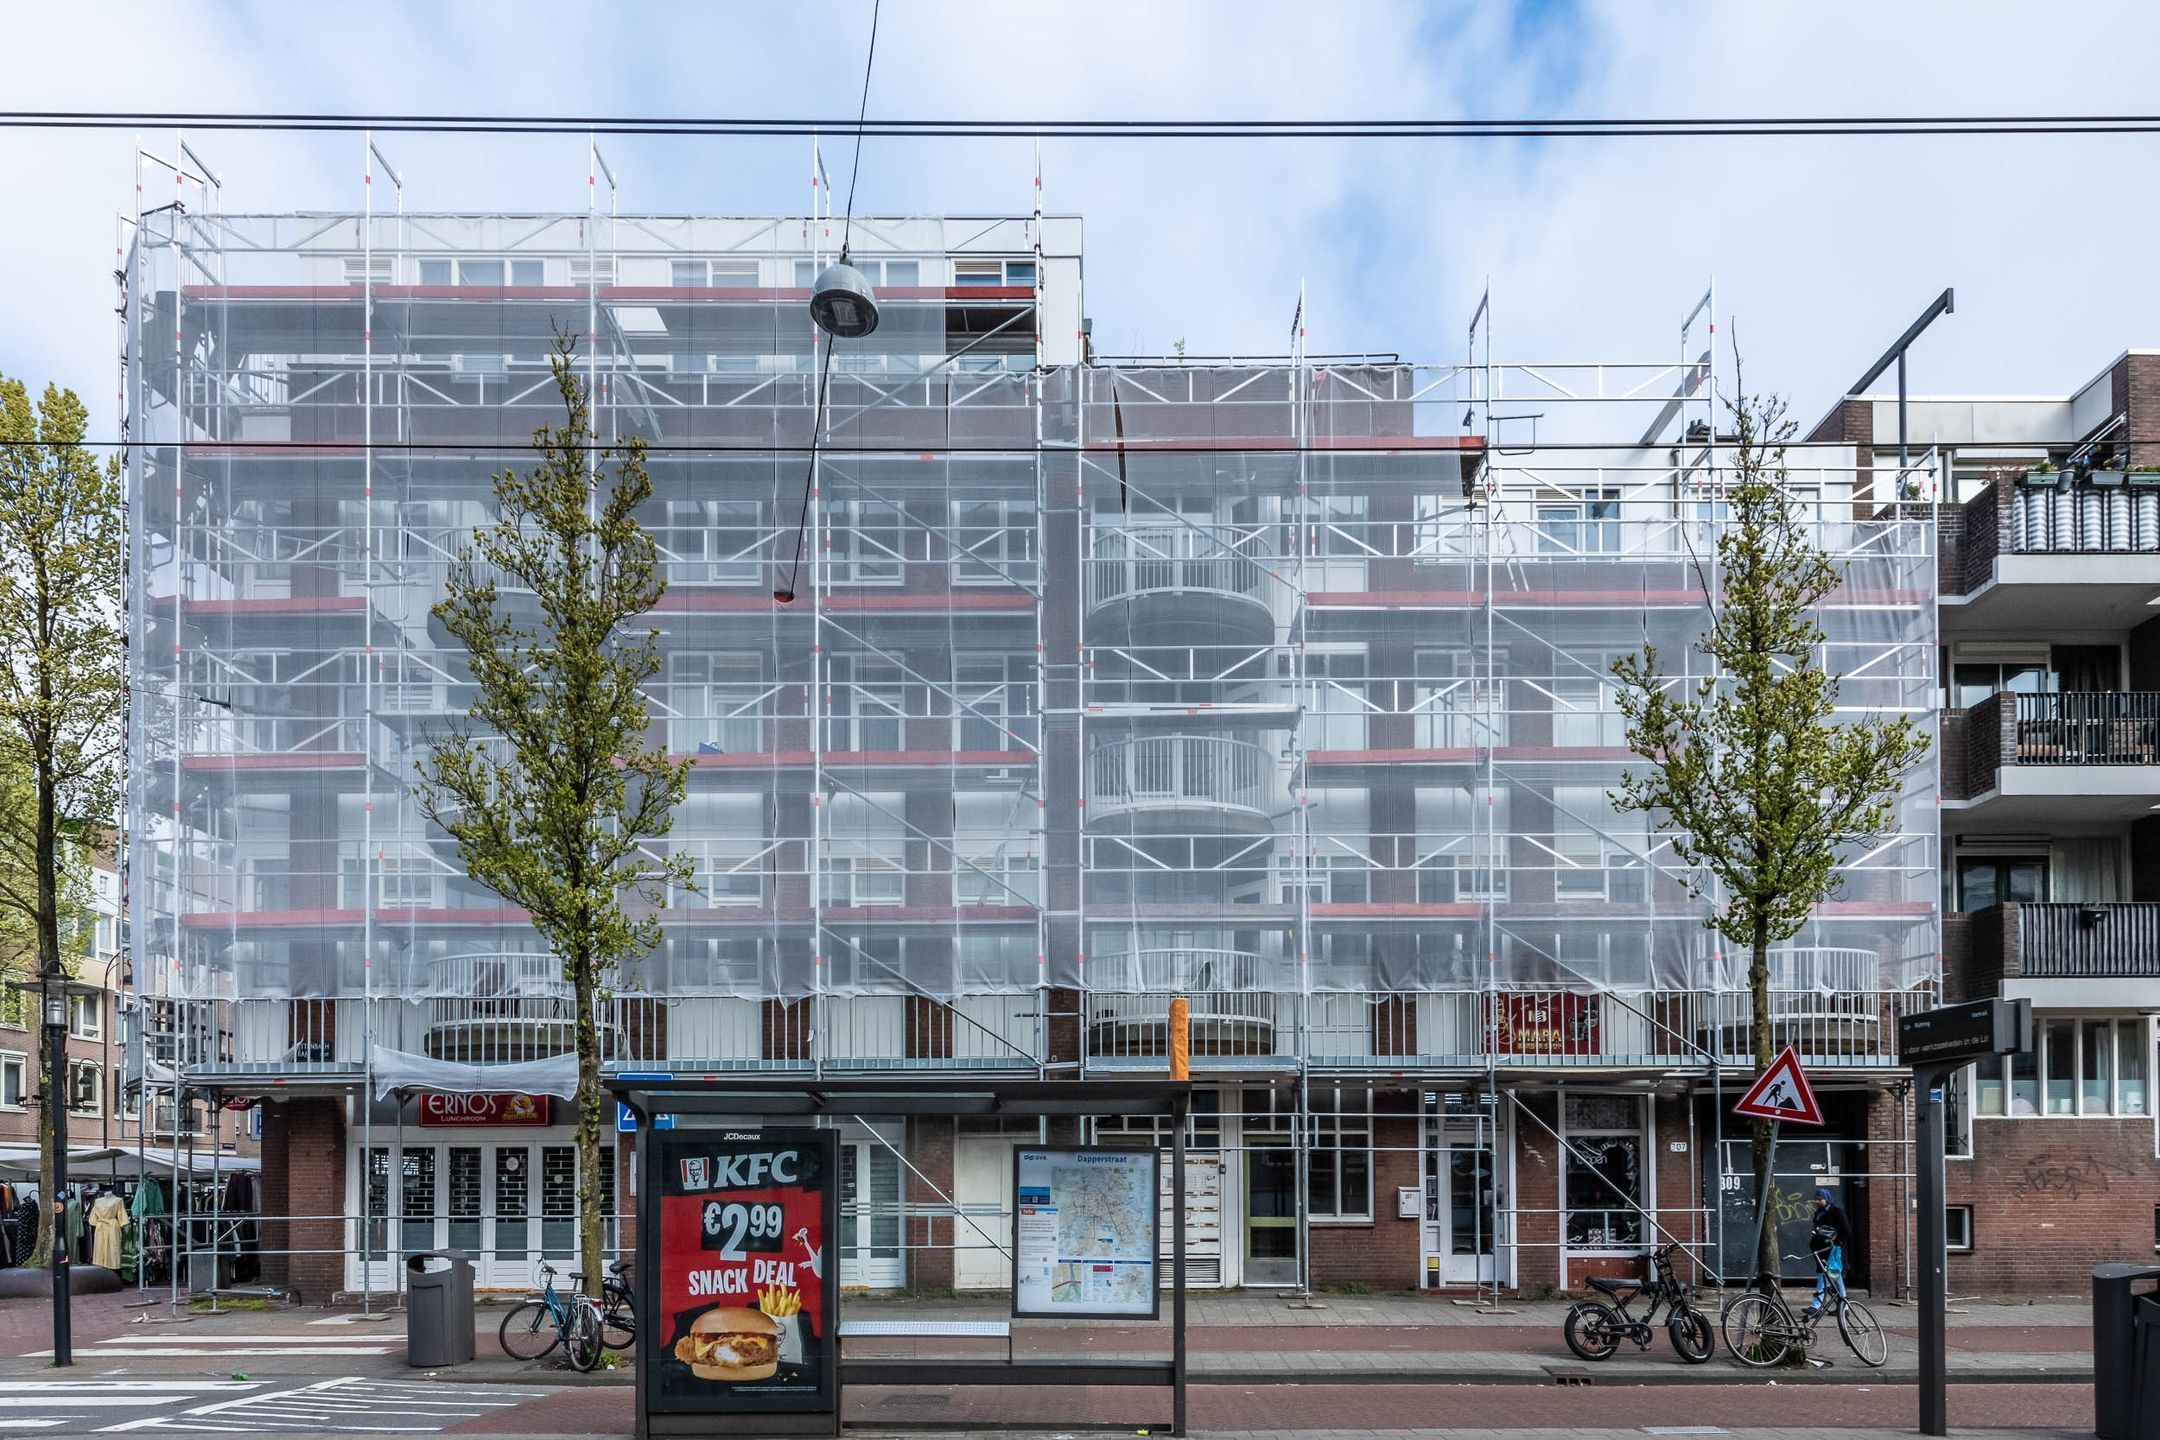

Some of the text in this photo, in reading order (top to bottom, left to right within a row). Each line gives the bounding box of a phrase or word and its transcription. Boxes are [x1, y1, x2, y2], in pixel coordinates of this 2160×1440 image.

[428, 1094, 498, 1114] ERNOS
[724, 1132, 761, 1141] JCDecaux
[713, 1150, 798, 1188] KFC
[1077, 1154, 1127, 1164] Dapperstraat
[688, 1258, 798, 1296] SNACK DEAL
